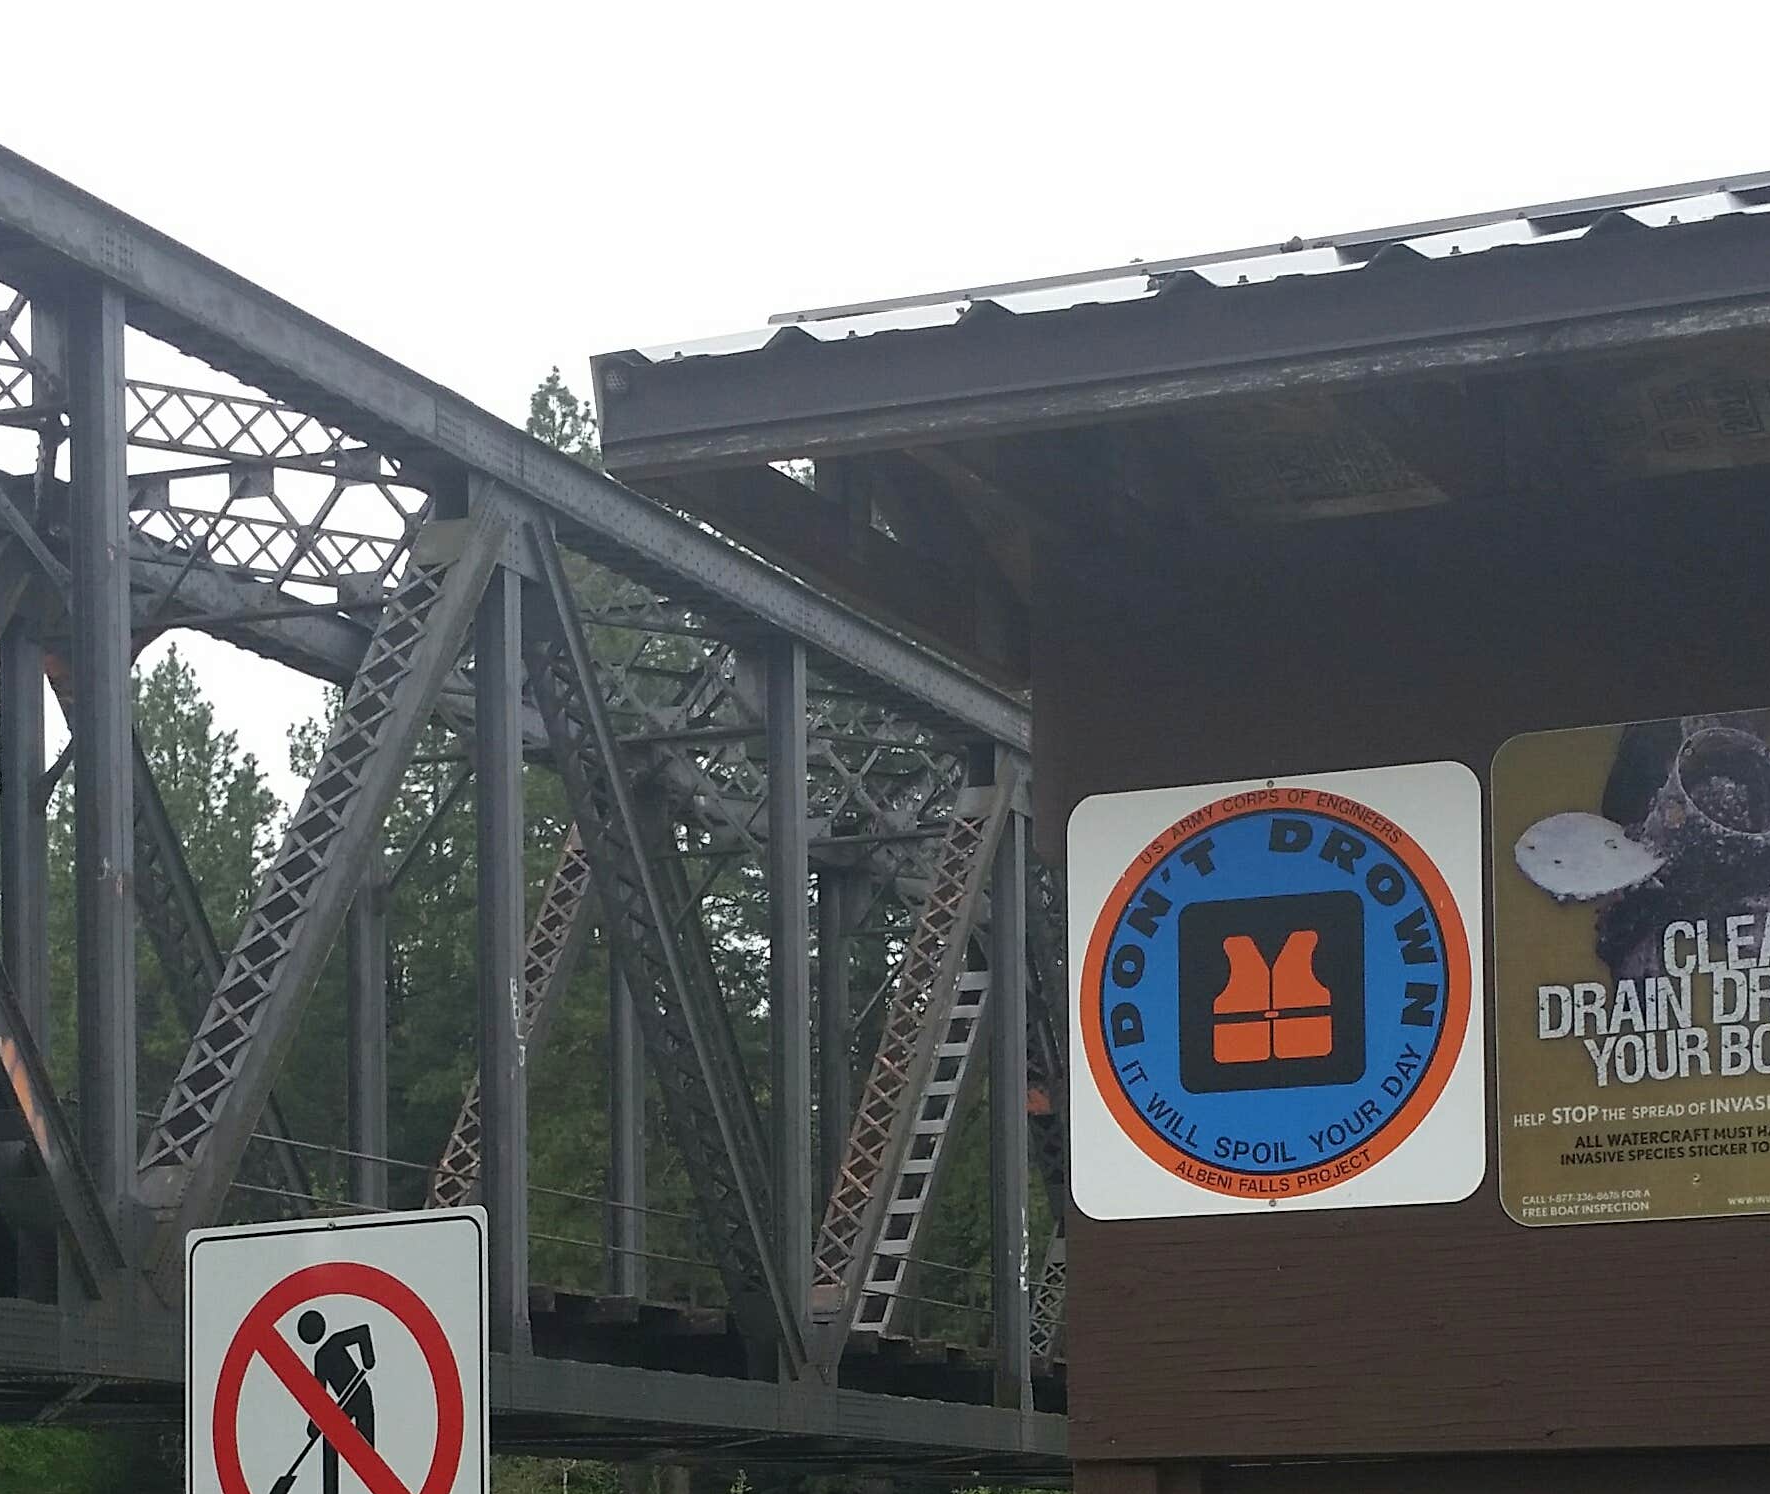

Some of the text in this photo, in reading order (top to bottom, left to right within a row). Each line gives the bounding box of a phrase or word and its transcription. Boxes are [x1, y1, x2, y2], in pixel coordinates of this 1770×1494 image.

[1140, 790, 1402, 864] US ARMY CORPS OF ENGINEERS
[1111, 818, 1438, 1048] DON'T DROWN
[1538, 974, 1691, 1040] DRAIN
[1584, 1027, 1710, 1088] YOUR
[1121, 1043, 1422, 1164] IT WILL SPOIL YOUR DAY
[1514, 1113, 1546, 1128] HELP
[1551, 1106, 1599, 1125] STOP
[1602, 1108, 1627, 1121] THE
[1632, 1104, 1685, 1120] SPREAD
[1688, 1103, 1707, 1116] OF
[1560, 1150, 1625, 1166] INVASIVE
[1628, 1146, 1685, 1162] SPECIES
[1688, 1142, 1748, 1158] STICKER
[1750, 1140, 1770, 1154] TO
[1574, 1134, 1604, 1149] ALL
[1606, 1127, 1710, 1148] WATERCRAFT
[1713, 1125, 1754, 1140] MUST
[1176, 1149, 1372, 1194] ALBENI FALLS PROJECT
